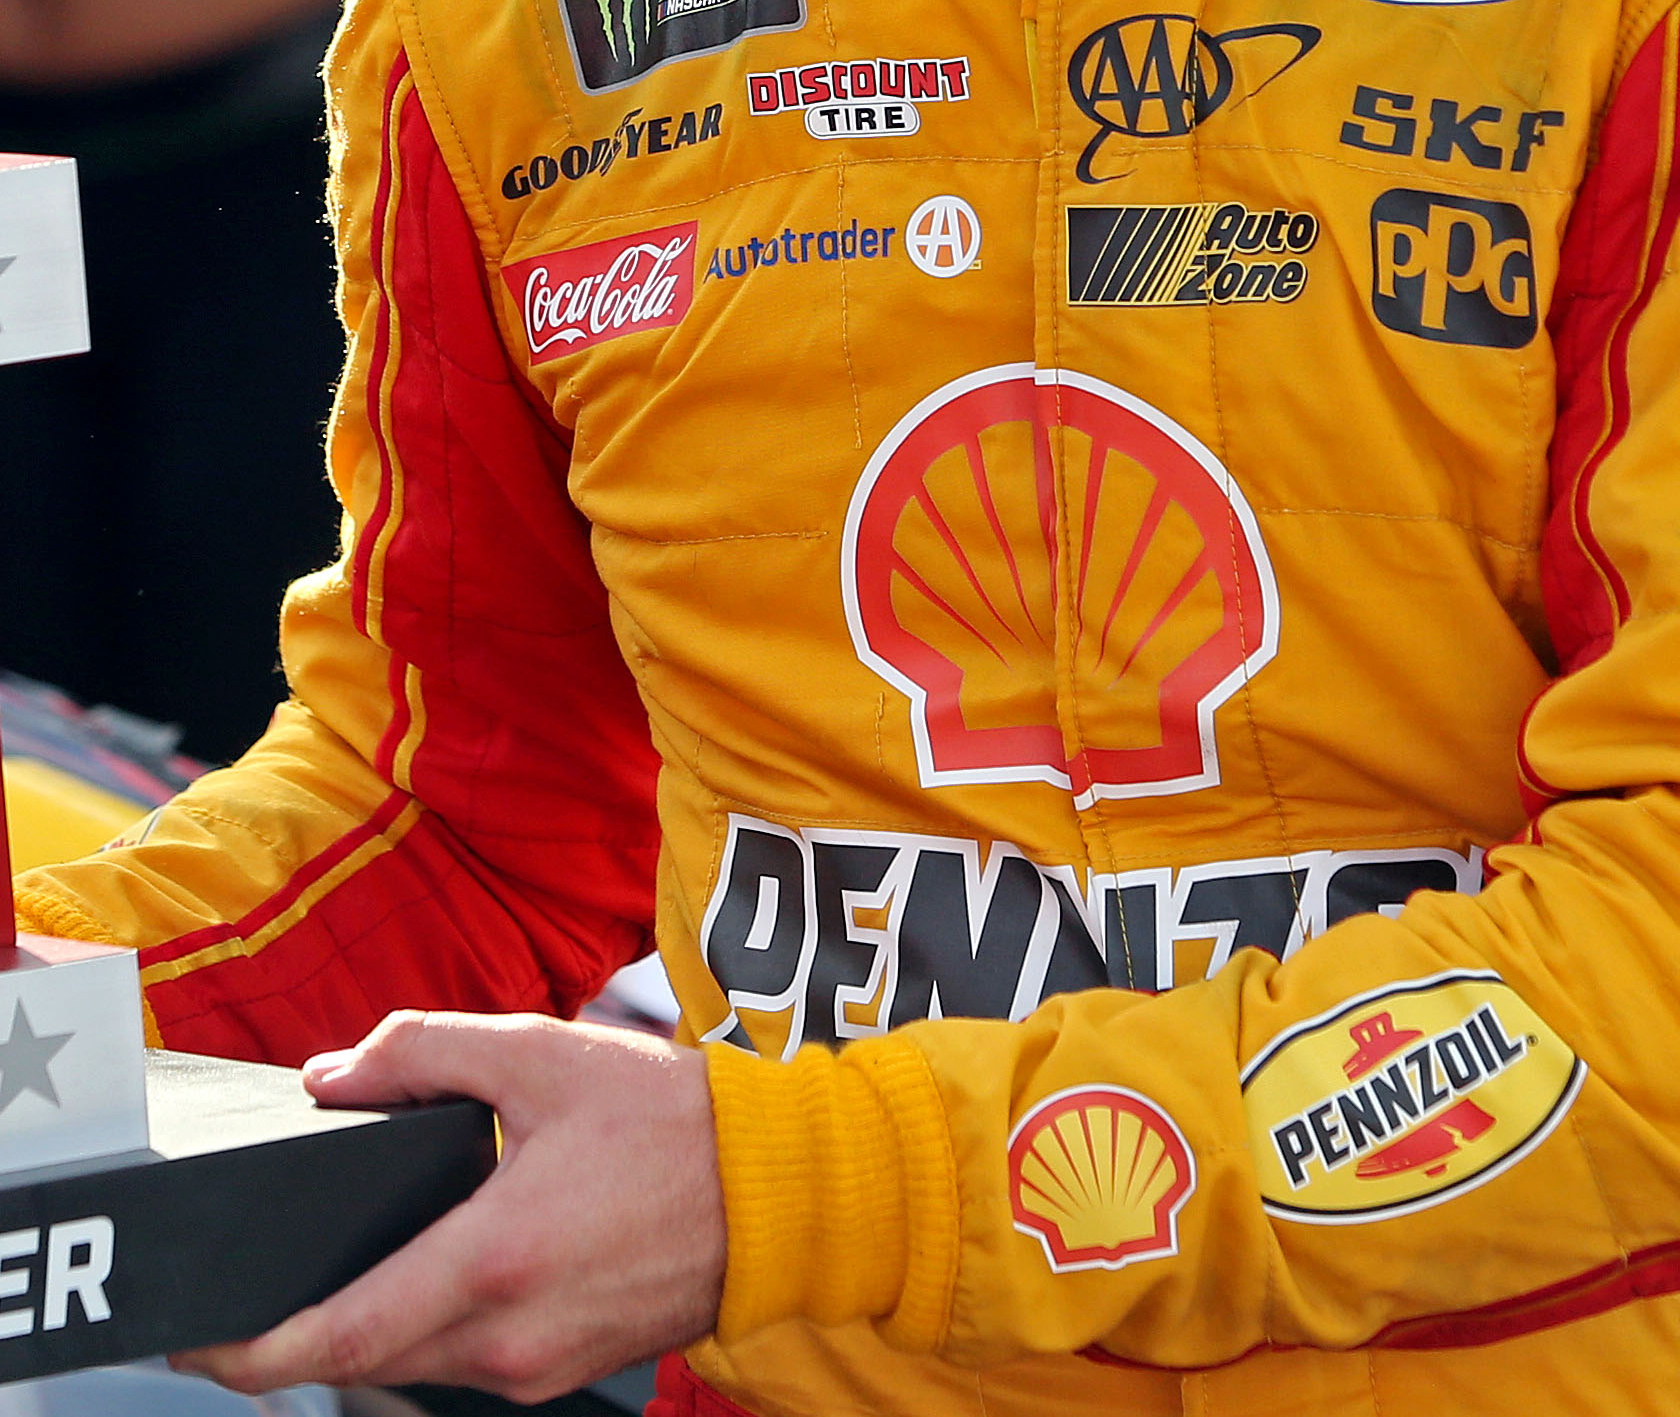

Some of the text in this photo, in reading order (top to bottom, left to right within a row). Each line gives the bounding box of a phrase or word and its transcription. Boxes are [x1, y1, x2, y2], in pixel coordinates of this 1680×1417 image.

[750, 60, 969, 114] DISCOUNT
[820, 105, 906, 131] TIRE
[1086, 16, 1211, 133] AAA
[501, 103, 723, 200] GOODYEAR
[1340, 85, 1565, 172] SKF
[703, 218, 896, 284] Autotrader
[1202, 202, 1319, 253] Auto
[1376, 204, 1530, 330] PPG
[524, 233, 694, 354] Coca-Cola
[1173, 254, 1307, 304] Zone
[1272, 1003, 1526, 1188] PENNZOIL
